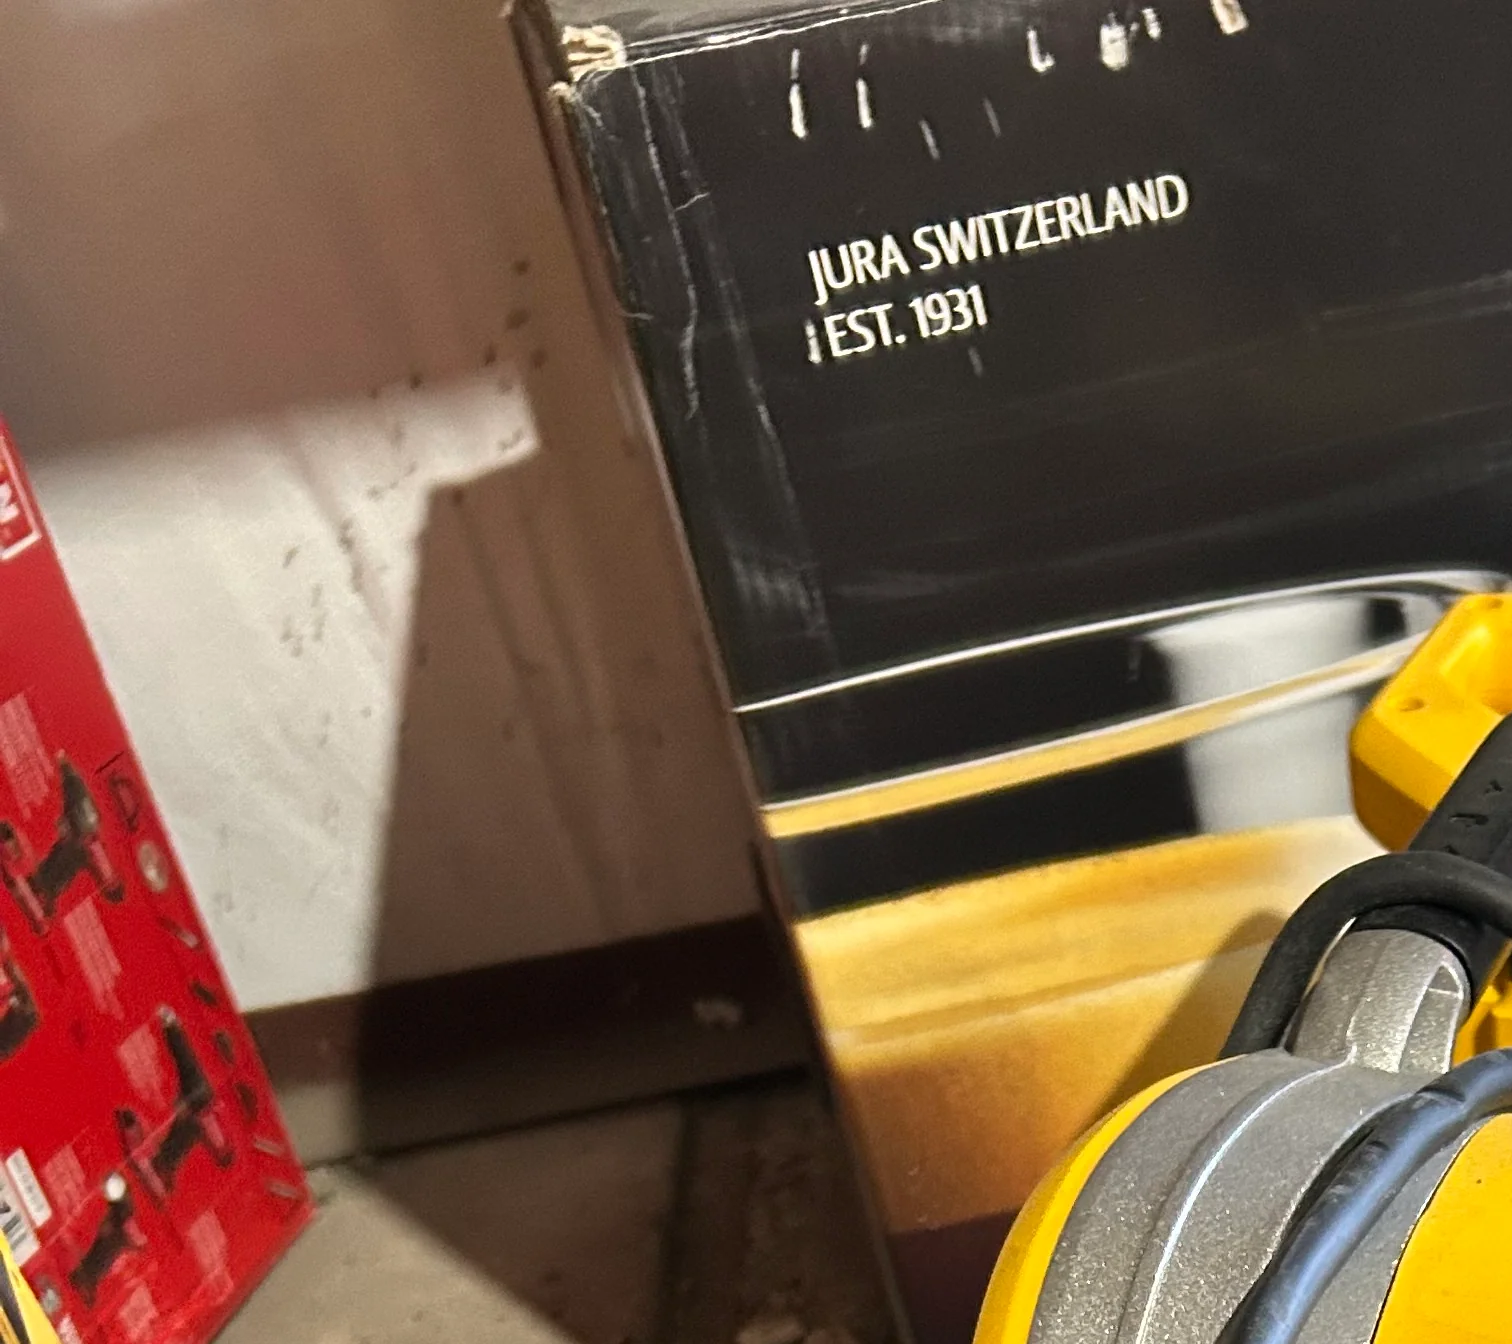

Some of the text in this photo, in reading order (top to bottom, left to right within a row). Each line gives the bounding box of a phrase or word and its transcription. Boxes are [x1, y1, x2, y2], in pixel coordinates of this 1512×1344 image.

[807, 173, 1190, 306] JURA SWITZERLAND
[823, 284, 990, 359] EST. 1931
